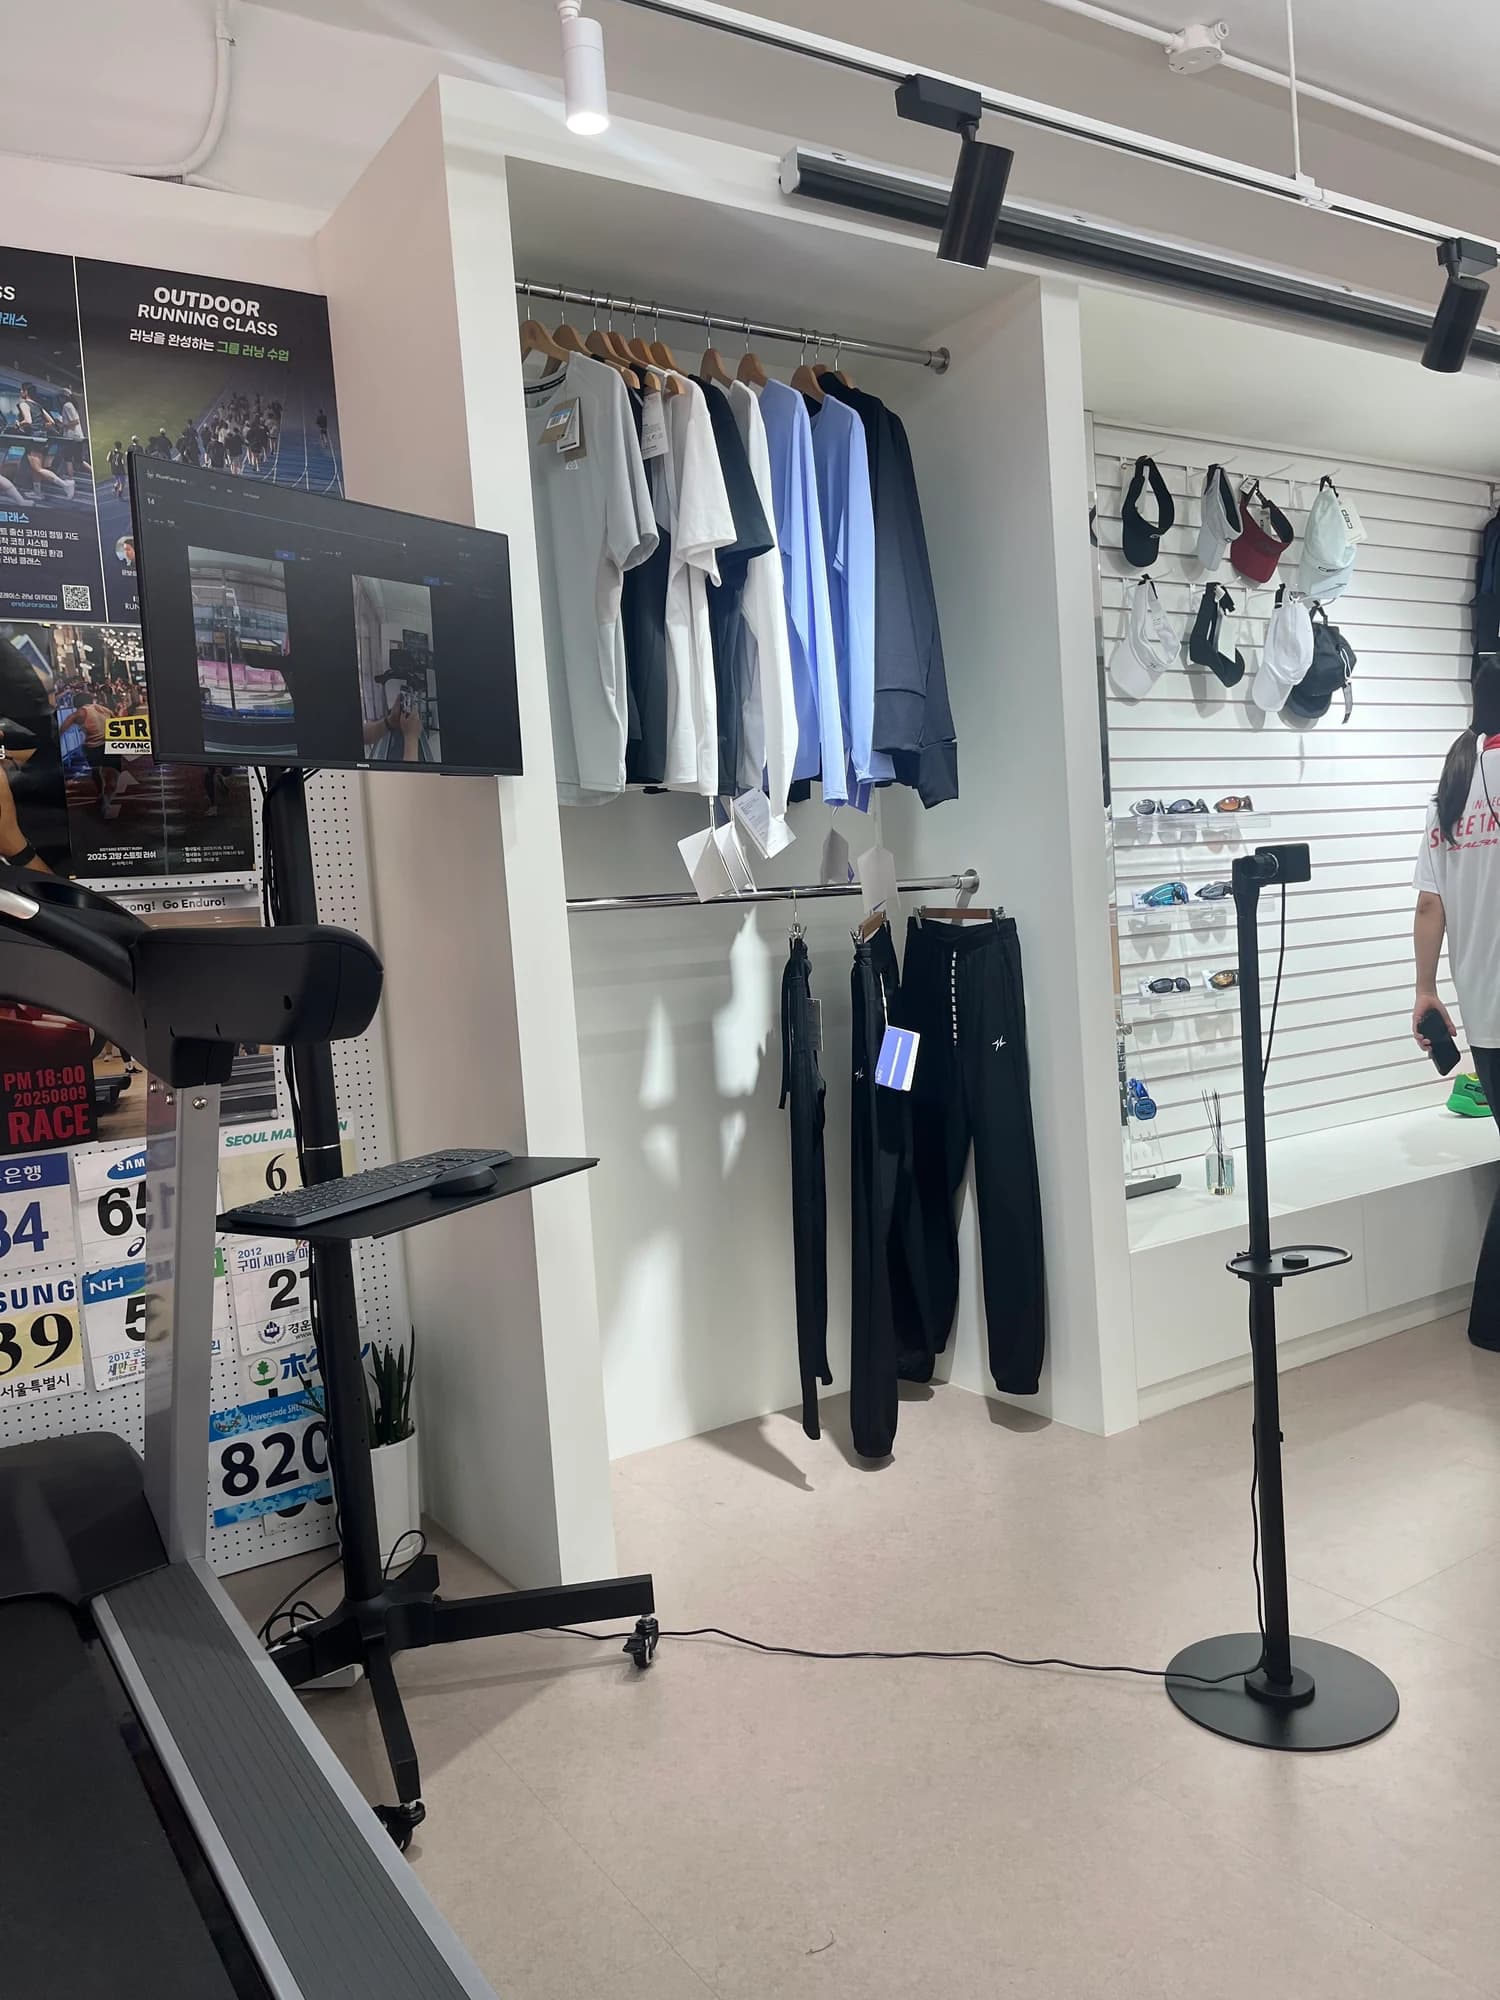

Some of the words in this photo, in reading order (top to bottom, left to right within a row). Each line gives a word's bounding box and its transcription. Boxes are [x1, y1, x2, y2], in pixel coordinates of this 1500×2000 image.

[153, 286, 261, 318] OUTDOOR
[137, 303, 219, 328] RUNNING
[222, 316, 279, 337] CLASS
[129, 328, 166, 345] 러닝을
[167, 333, 215, 352] 완성하는
[242, 344, 265, 358] 러닝
[266, 347, 289, 362] 수업
[108, 717, 149, 738] STR
[86, 852, 108, 862] 2025
[162, 899, 180, 910] Go
[181, 896, 226, 910] Enduro!
[3, 1071, 33, 1092] PM
[35, 1064, 86, 1088] 18:00
[14, 1085, 88, 1108] 20250809
[7, 1103, 91, 1145] RACE
[225, 1131, 269, 1148] SEOUL
[0, 1164, 42, 1185] 은행
[237, 1246, 263, 1259] 2012
[237, 1257, 261, 1273] 구미
[263, 1249, 297, 1268] 새마을
[89, 1276, 125, 1295] NH
[107, 1358, 140, 1376] 새만금
[108, 1351, 131, 1364] 2012
[0, 1373, 70, 1399] 서울특별시
[220, 1421, 330, 1498] 820
